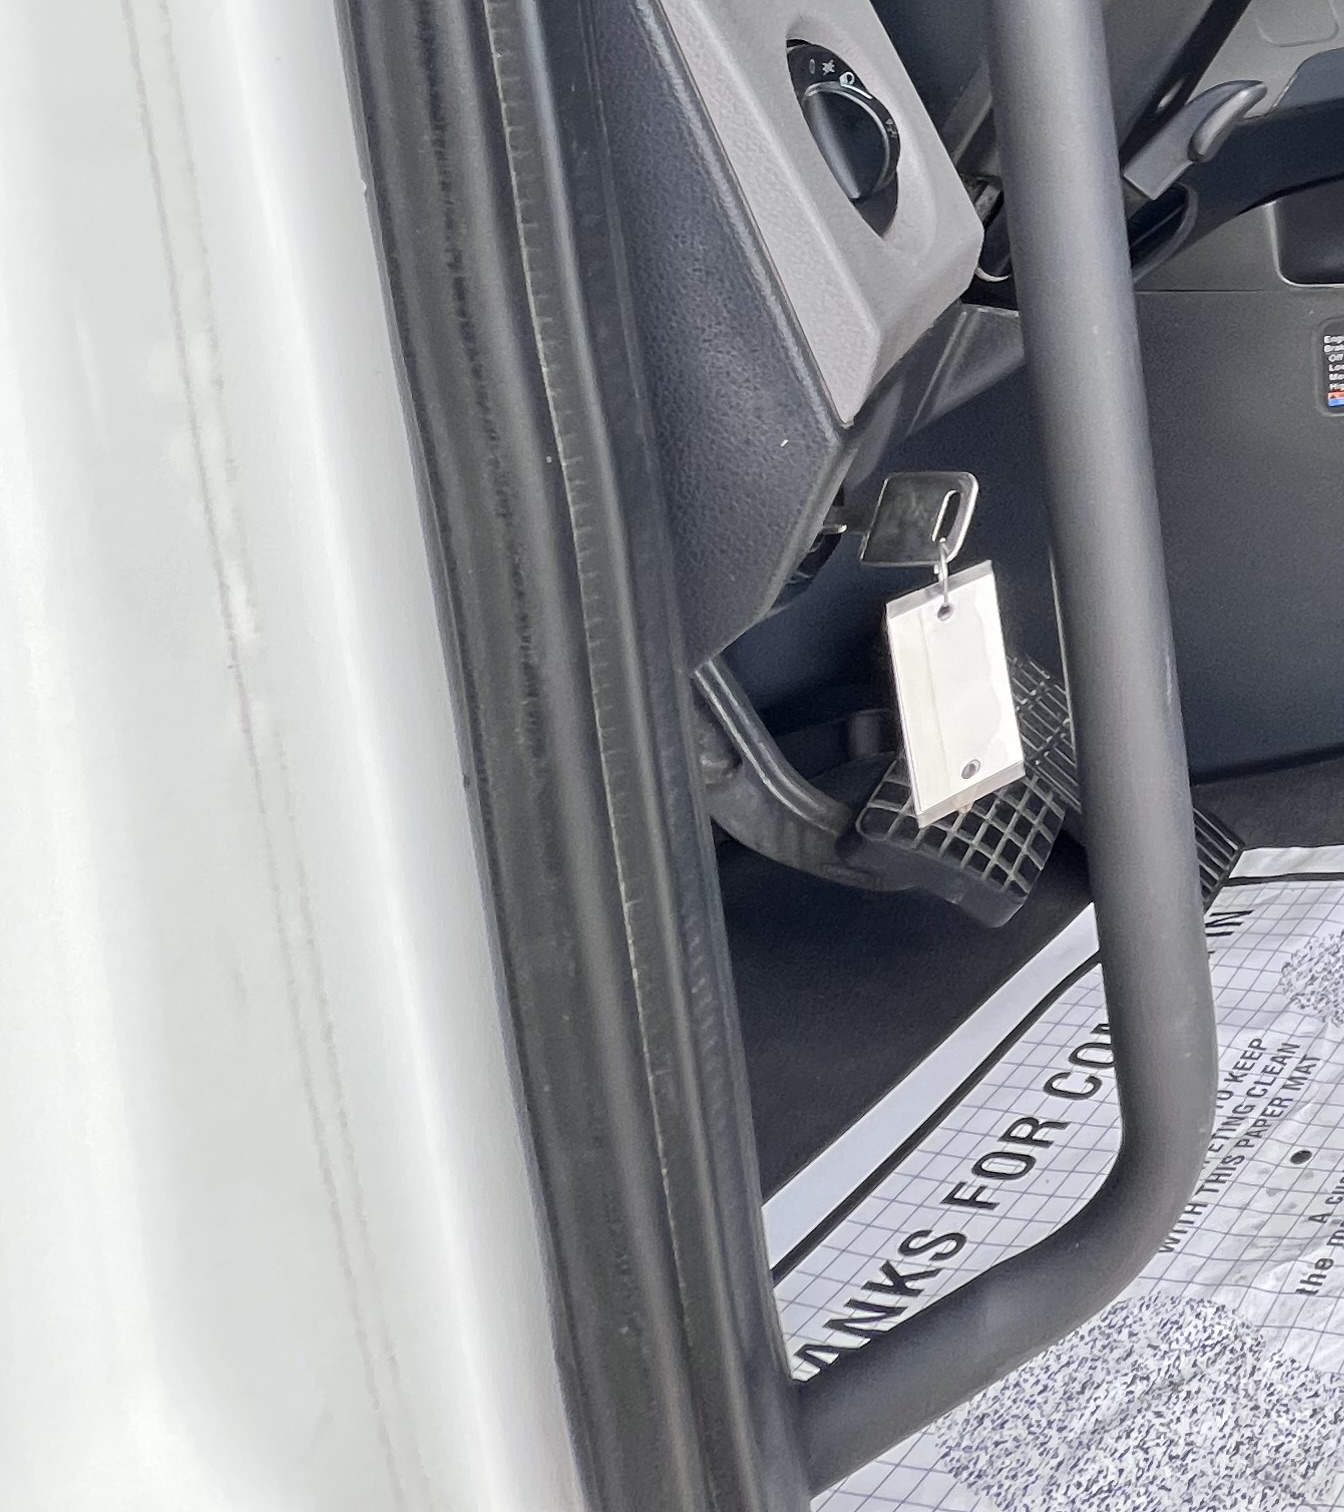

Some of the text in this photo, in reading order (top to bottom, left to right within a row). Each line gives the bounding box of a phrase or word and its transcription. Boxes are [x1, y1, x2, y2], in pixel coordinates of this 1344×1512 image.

[1224, 1038, 1267, 1083] KEEP
[1246, 1042, 1300, 1098] CLEAN
[1194, 1155, 1245, 1193] THIS
[1234, 1097, 1294, 1148] PAPER
[1280, 1054, 1321, 1091] MAT
[941, 1116, 1069, 1211] FOR
[1308, 1211, 1333, 1224] A
[1295, 1256, 1334, 1296] the
